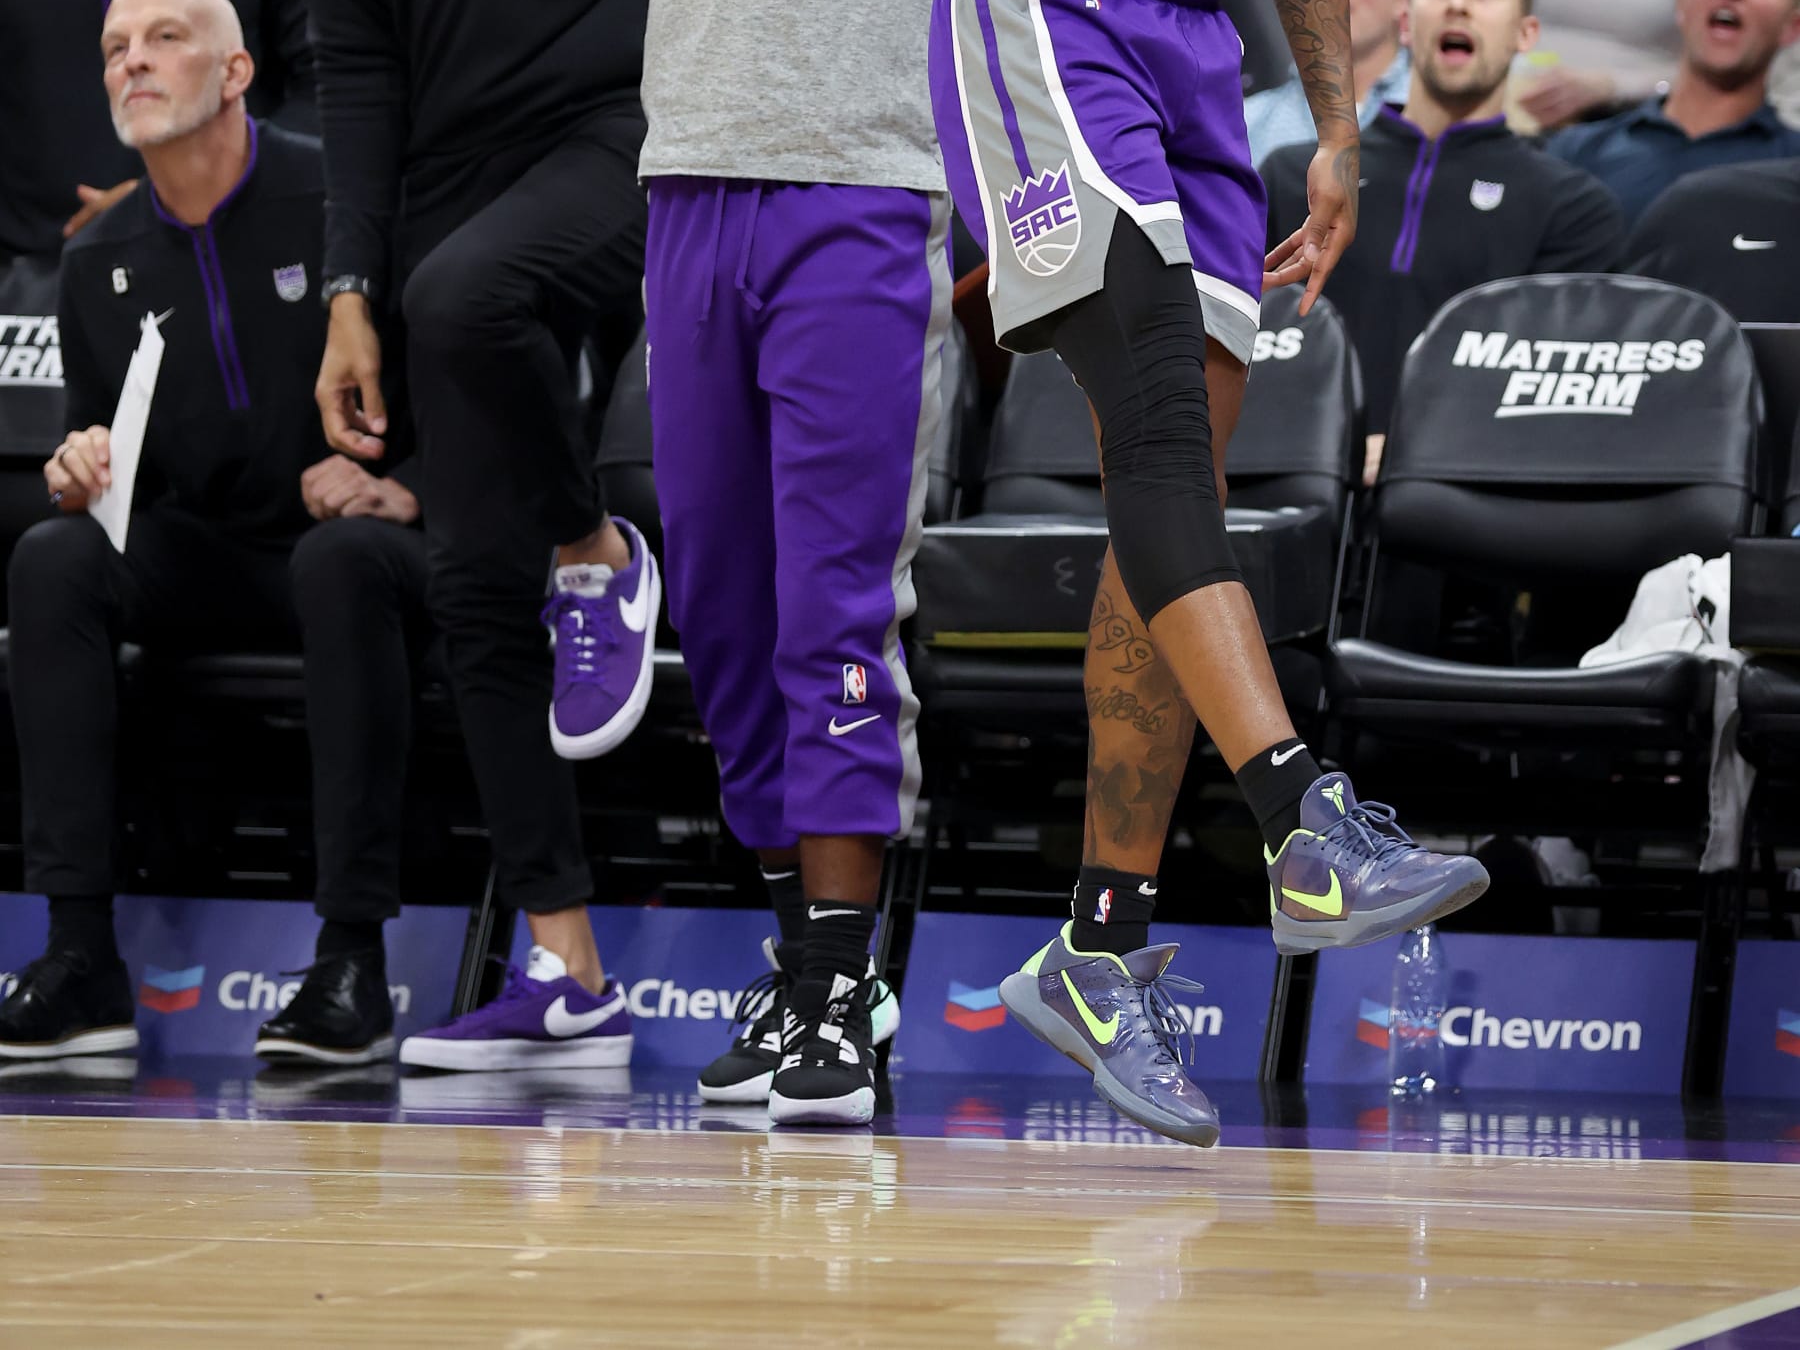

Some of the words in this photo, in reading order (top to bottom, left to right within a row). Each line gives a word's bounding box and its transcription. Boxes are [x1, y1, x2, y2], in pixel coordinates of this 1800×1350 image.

[1011, 198, 1077, 248] SAC
[1452, 330, 1706, 372] MATTRESS
[1501, 371, 1646, 408] FIRM
[218, 970, 411, 1013] Chen
[1439, 1006, 1642, 1051] Chevron
